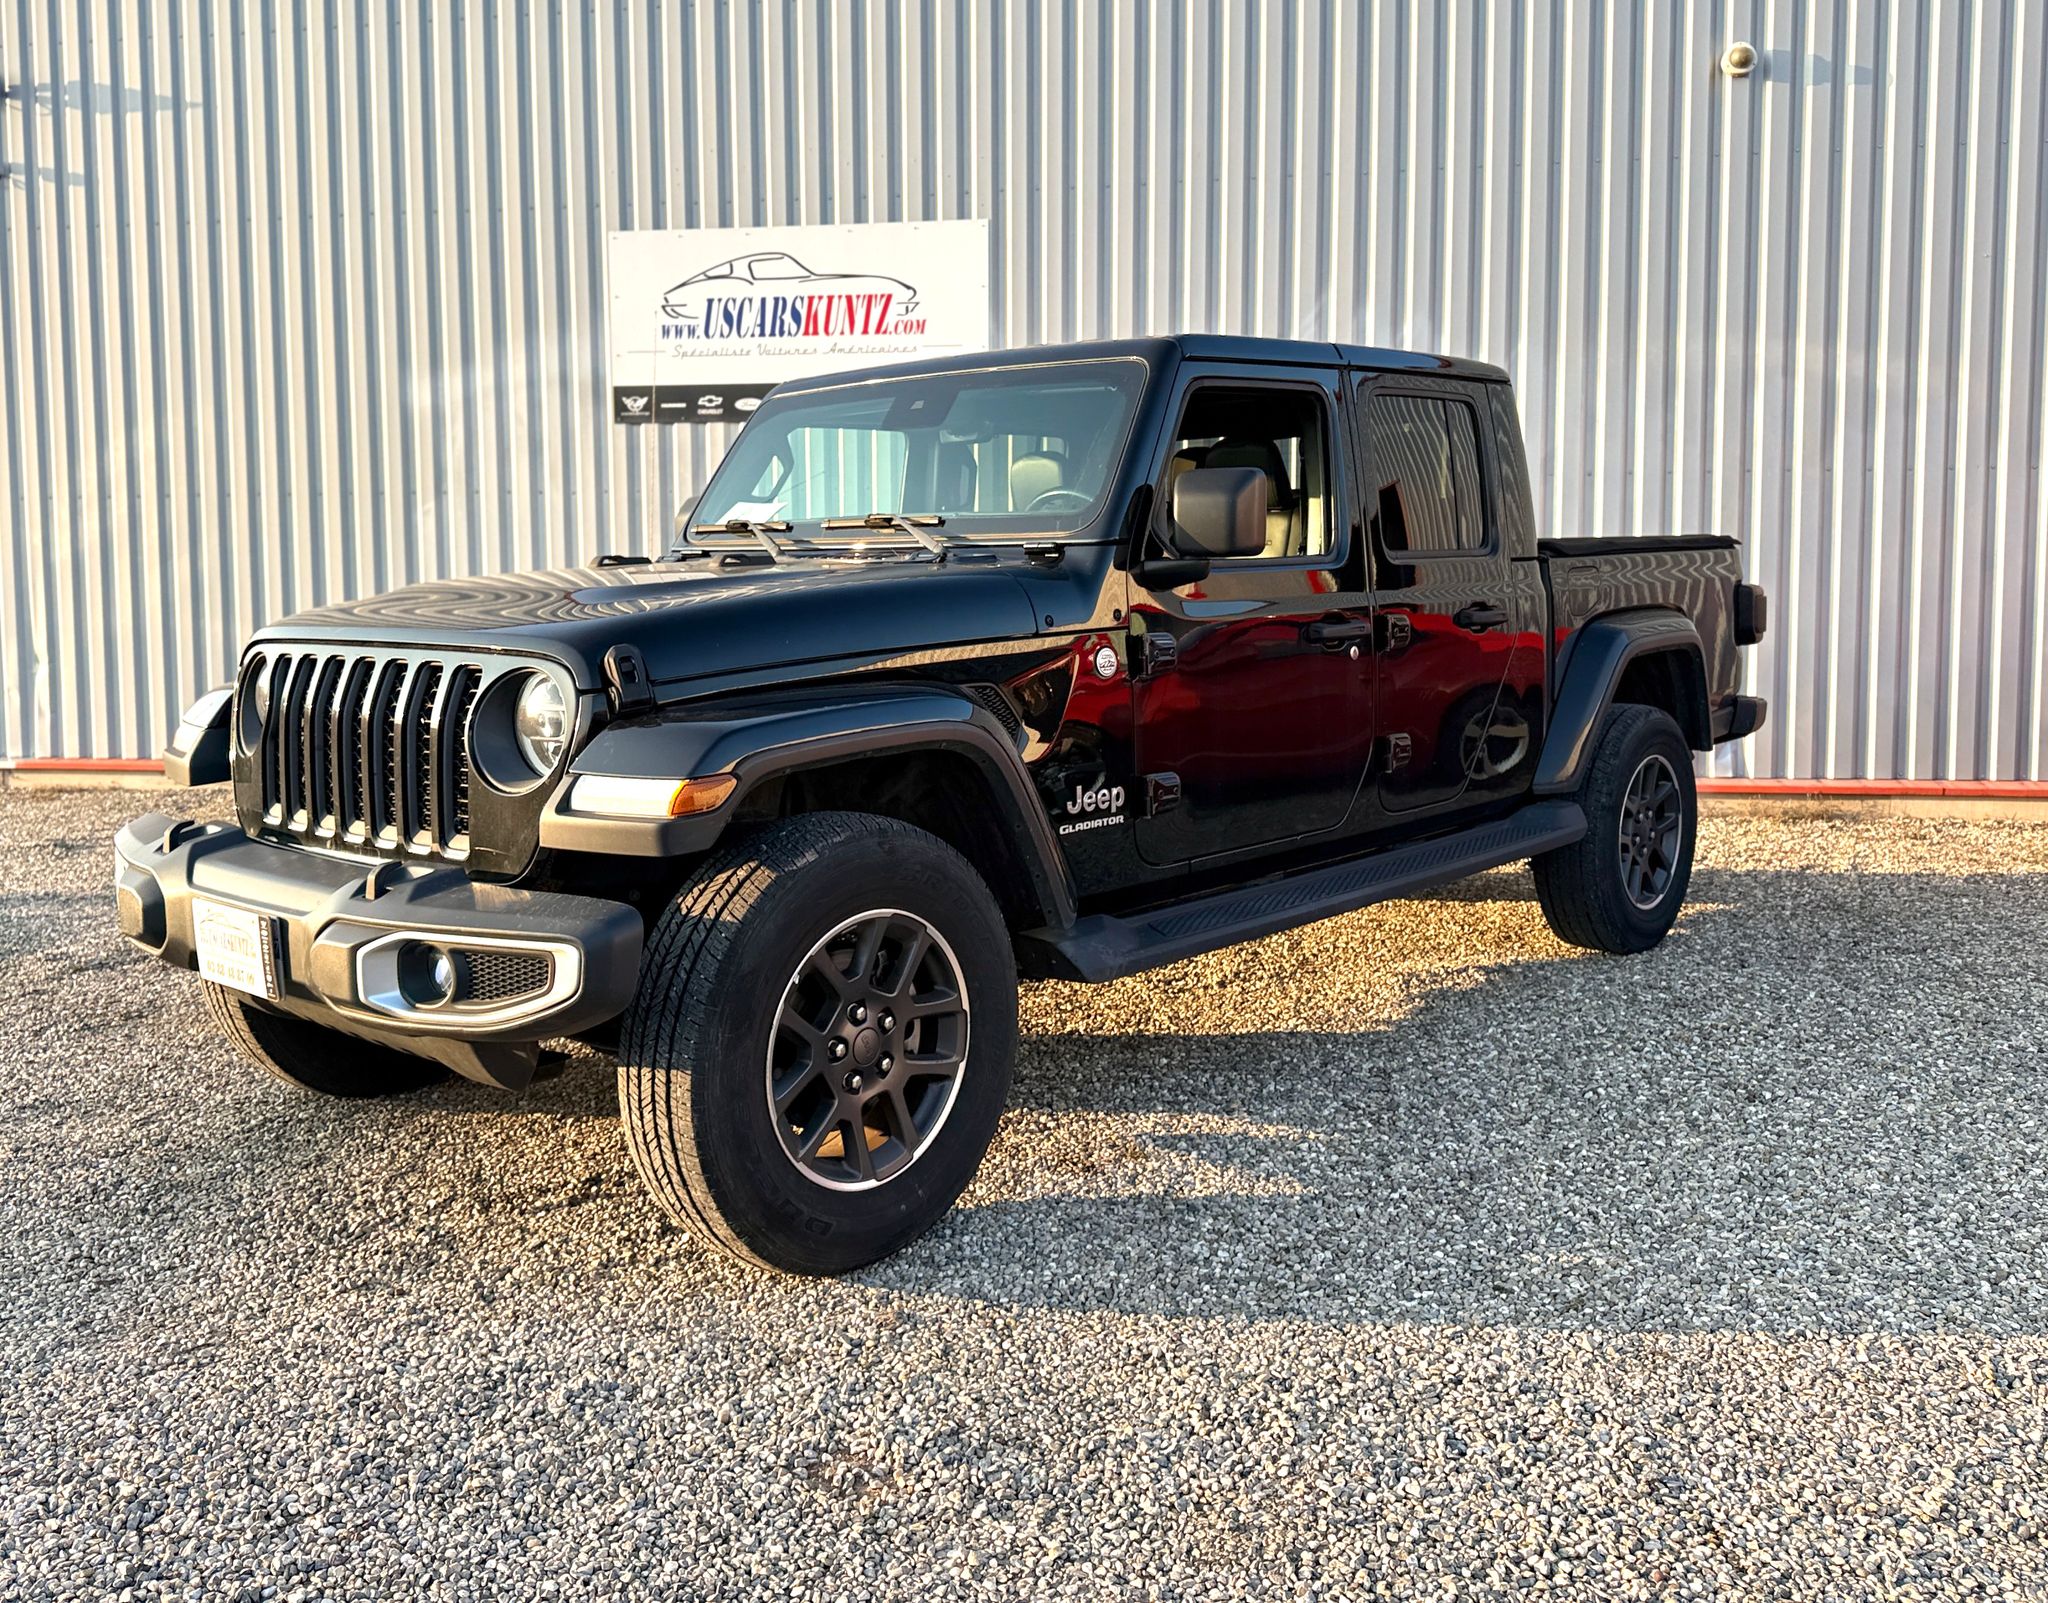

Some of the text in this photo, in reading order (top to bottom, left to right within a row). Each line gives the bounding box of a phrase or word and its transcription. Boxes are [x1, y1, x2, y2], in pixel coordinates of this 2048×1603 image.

[672, 342, 917, 359] Spécialiste Voitures Américaines
[1066, 785, 1125, 814] Jeep
[1059, 815, 1124, 835] GLADIATOR
